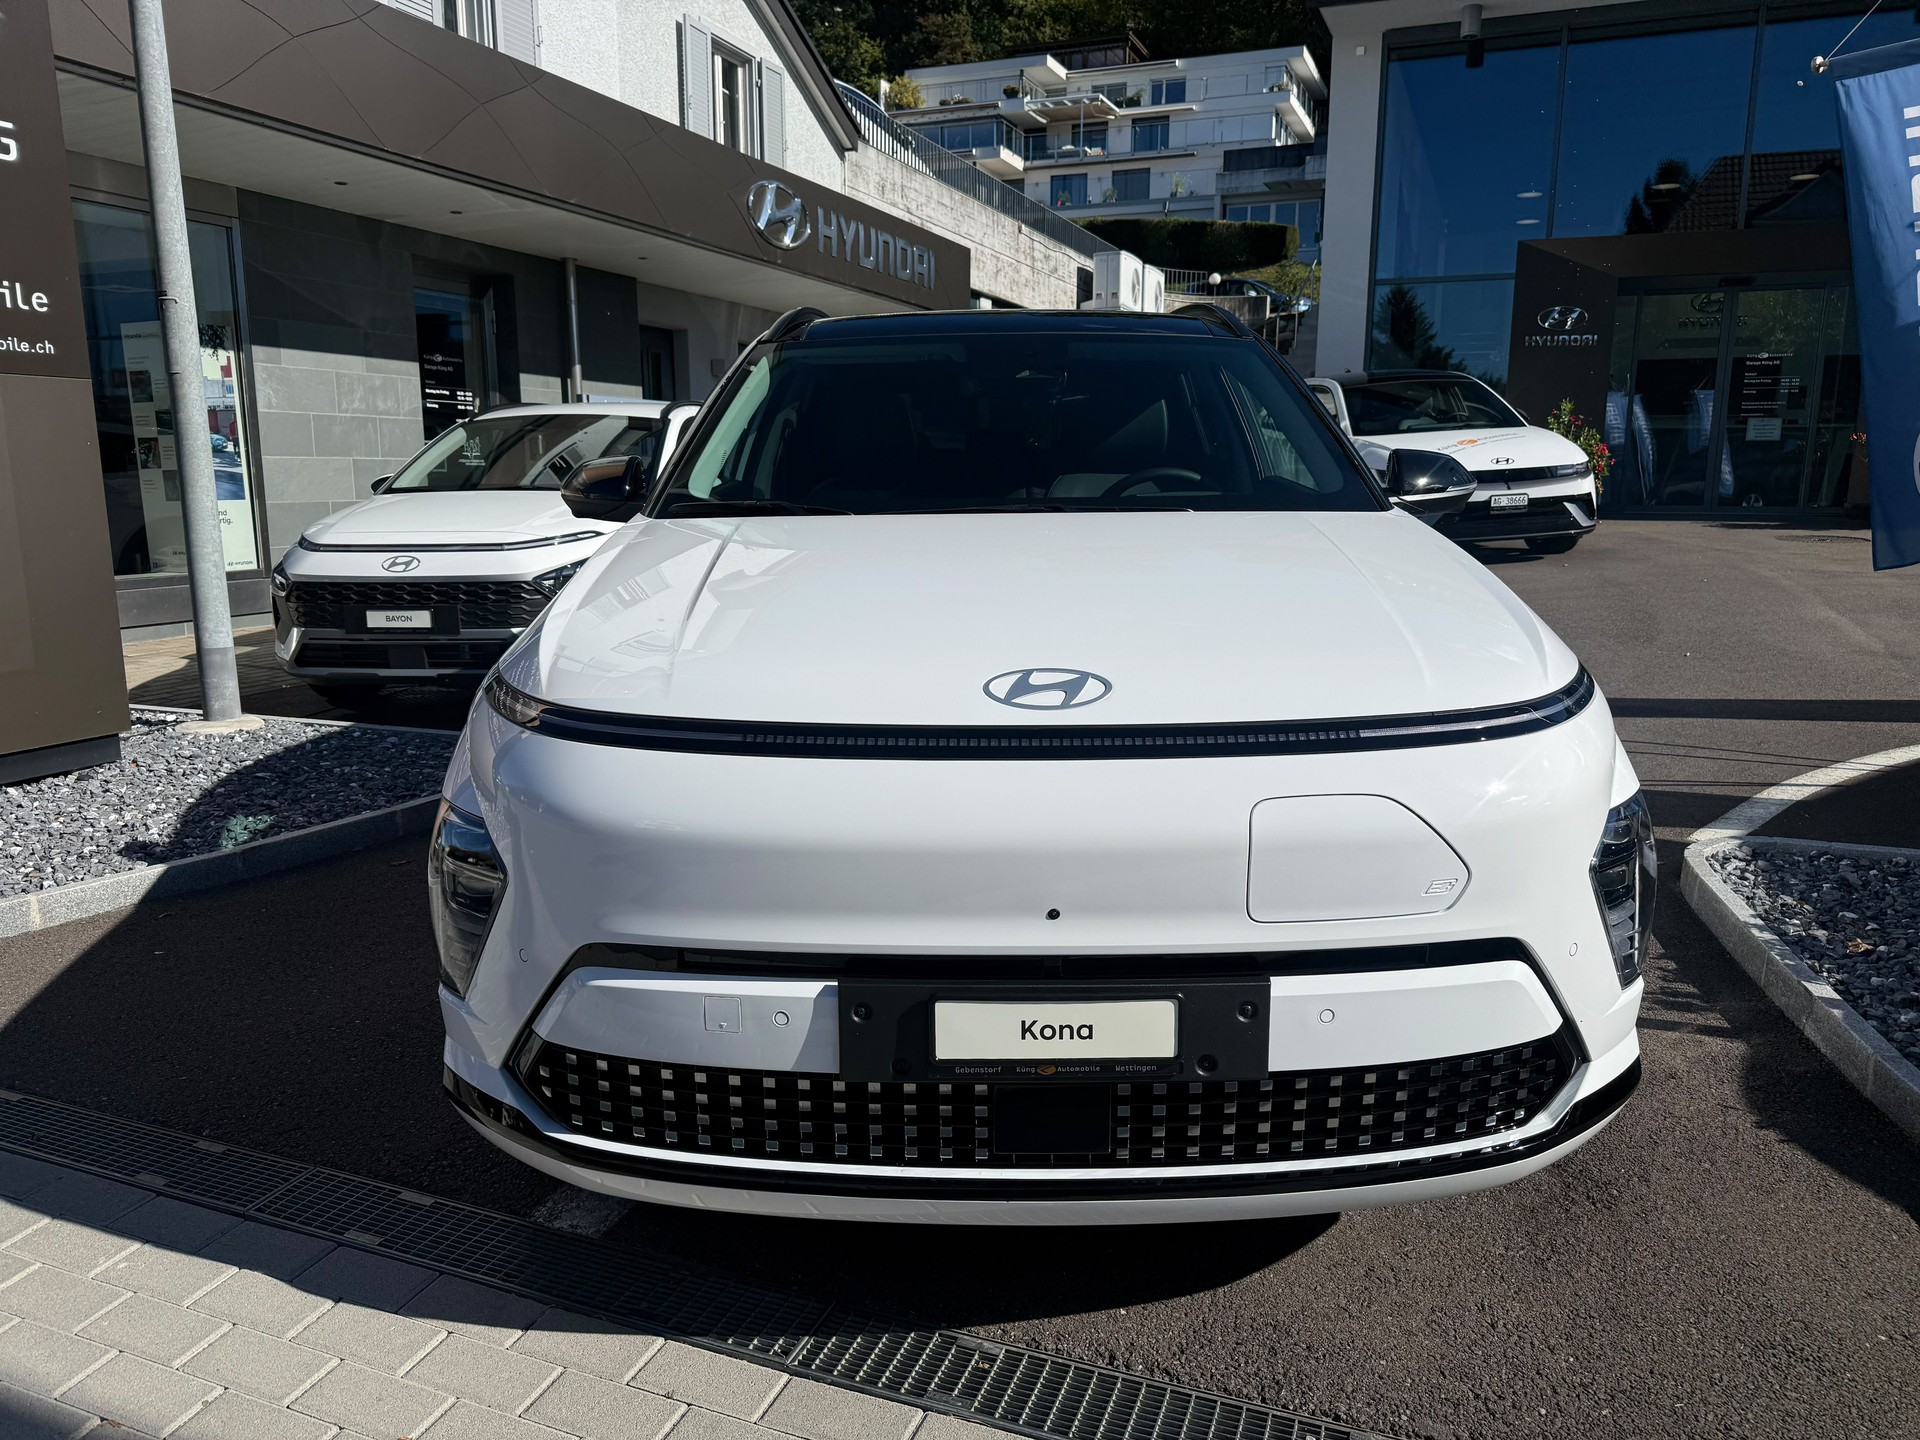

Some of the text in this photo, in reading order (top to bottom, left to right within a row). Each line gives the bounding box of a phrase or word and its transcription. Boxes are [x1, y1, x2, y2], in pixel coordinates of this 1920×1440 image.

[817, 205, 936, 290] HYUNDAI
[1524, 334, 1599, 347] HYUNDAI
[385, 615, 413, 623] BAYON
[1020, 1019, 1094, 1041] Kona
[954, 1063, 1158, 1074] Gebenstorf Küng Automobile Wettingen
